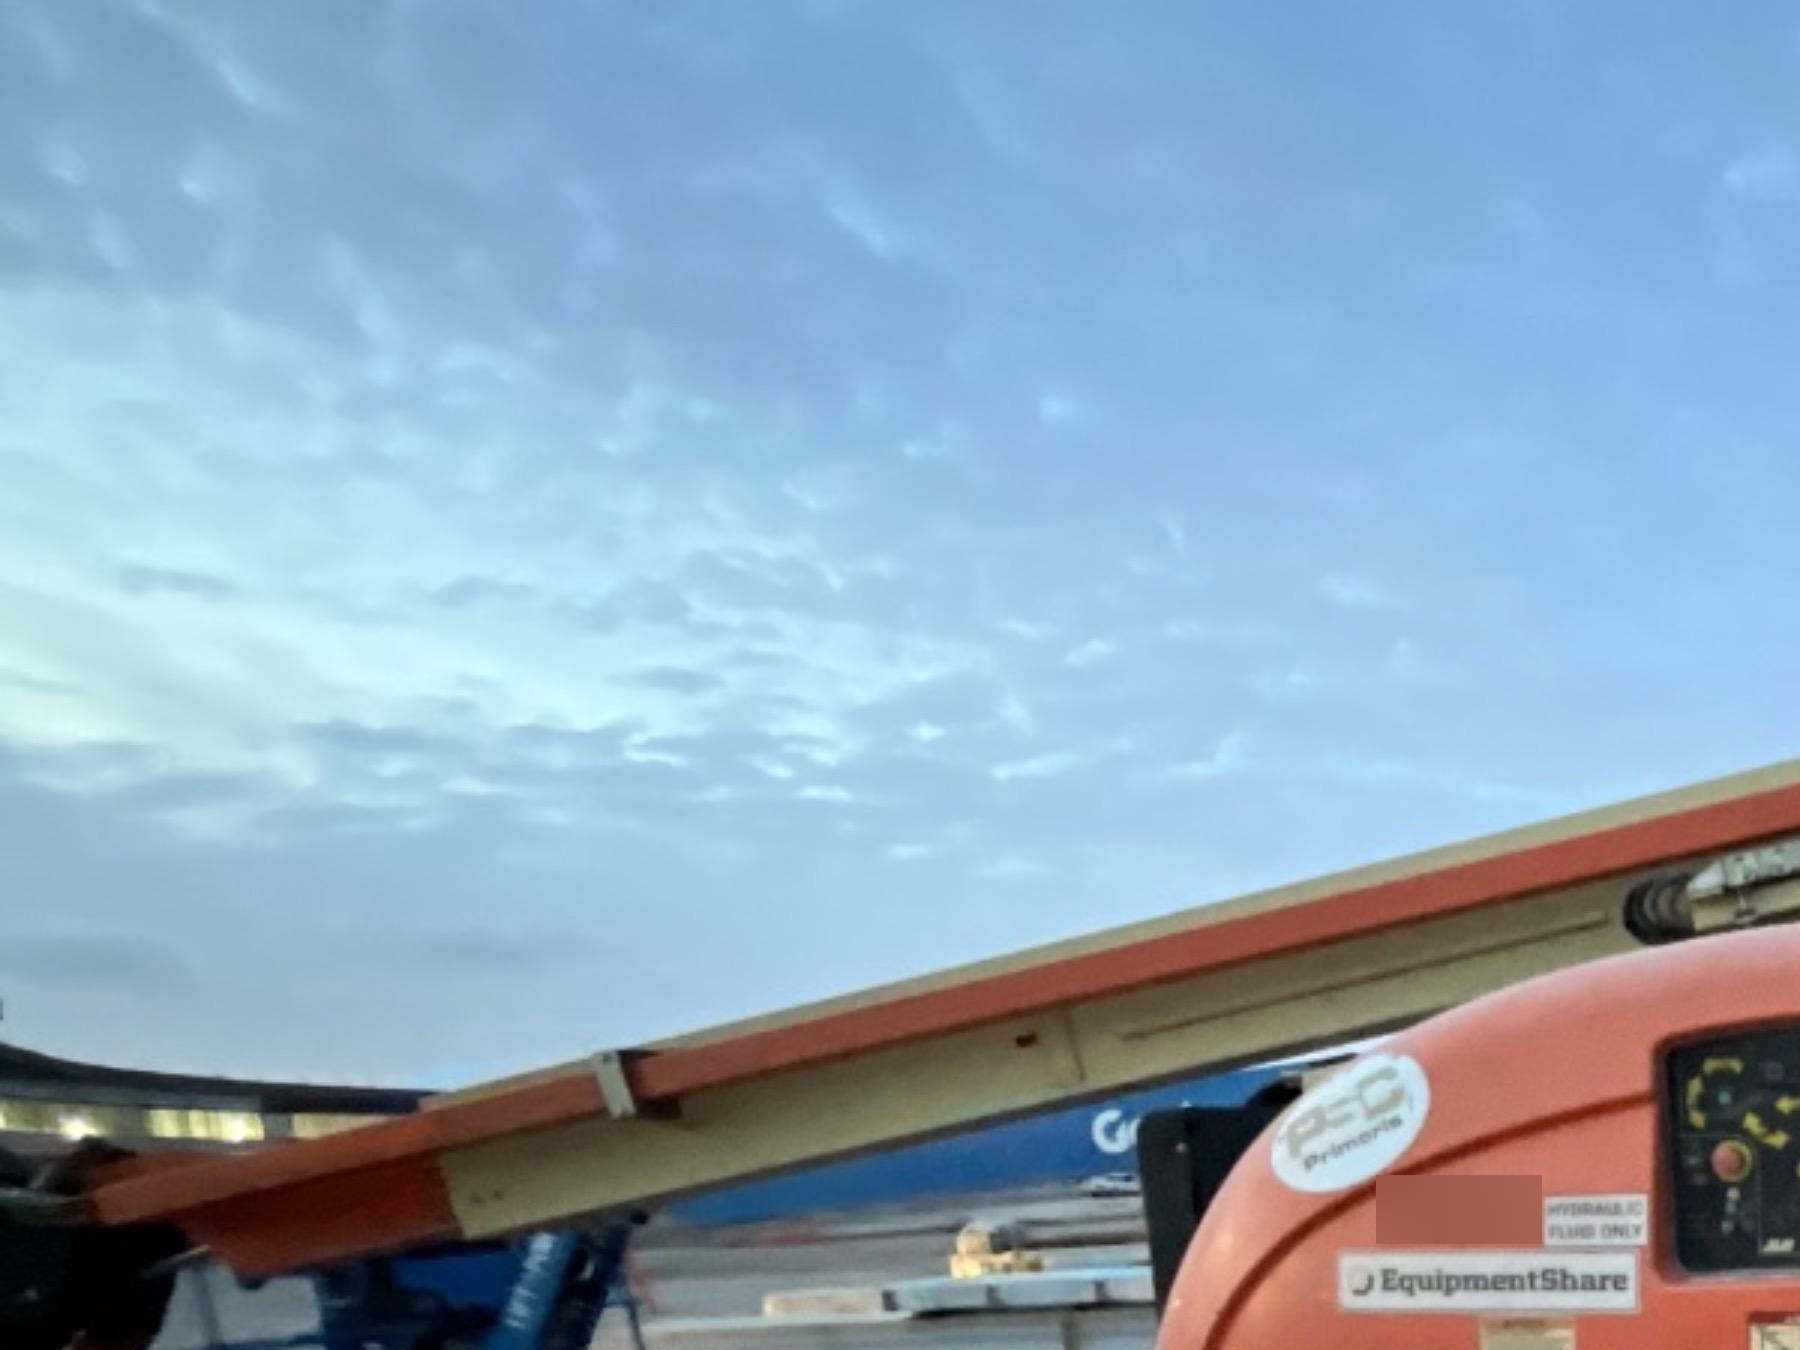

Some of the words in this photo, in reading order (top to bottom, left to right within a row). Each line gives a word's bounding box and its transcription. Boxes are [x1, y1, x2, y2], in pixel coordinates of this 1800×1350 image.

[1303, 1112, 1404, 1173] Primoris
[1547, 1201, 1643, 1217] HYDRAULIC
[1547, 1224, 1597, 1240] FLUID
[1600, 1223, 1643, 1239] ONLY
[1380, 1267, 1629, 1297] EquipmentShare
